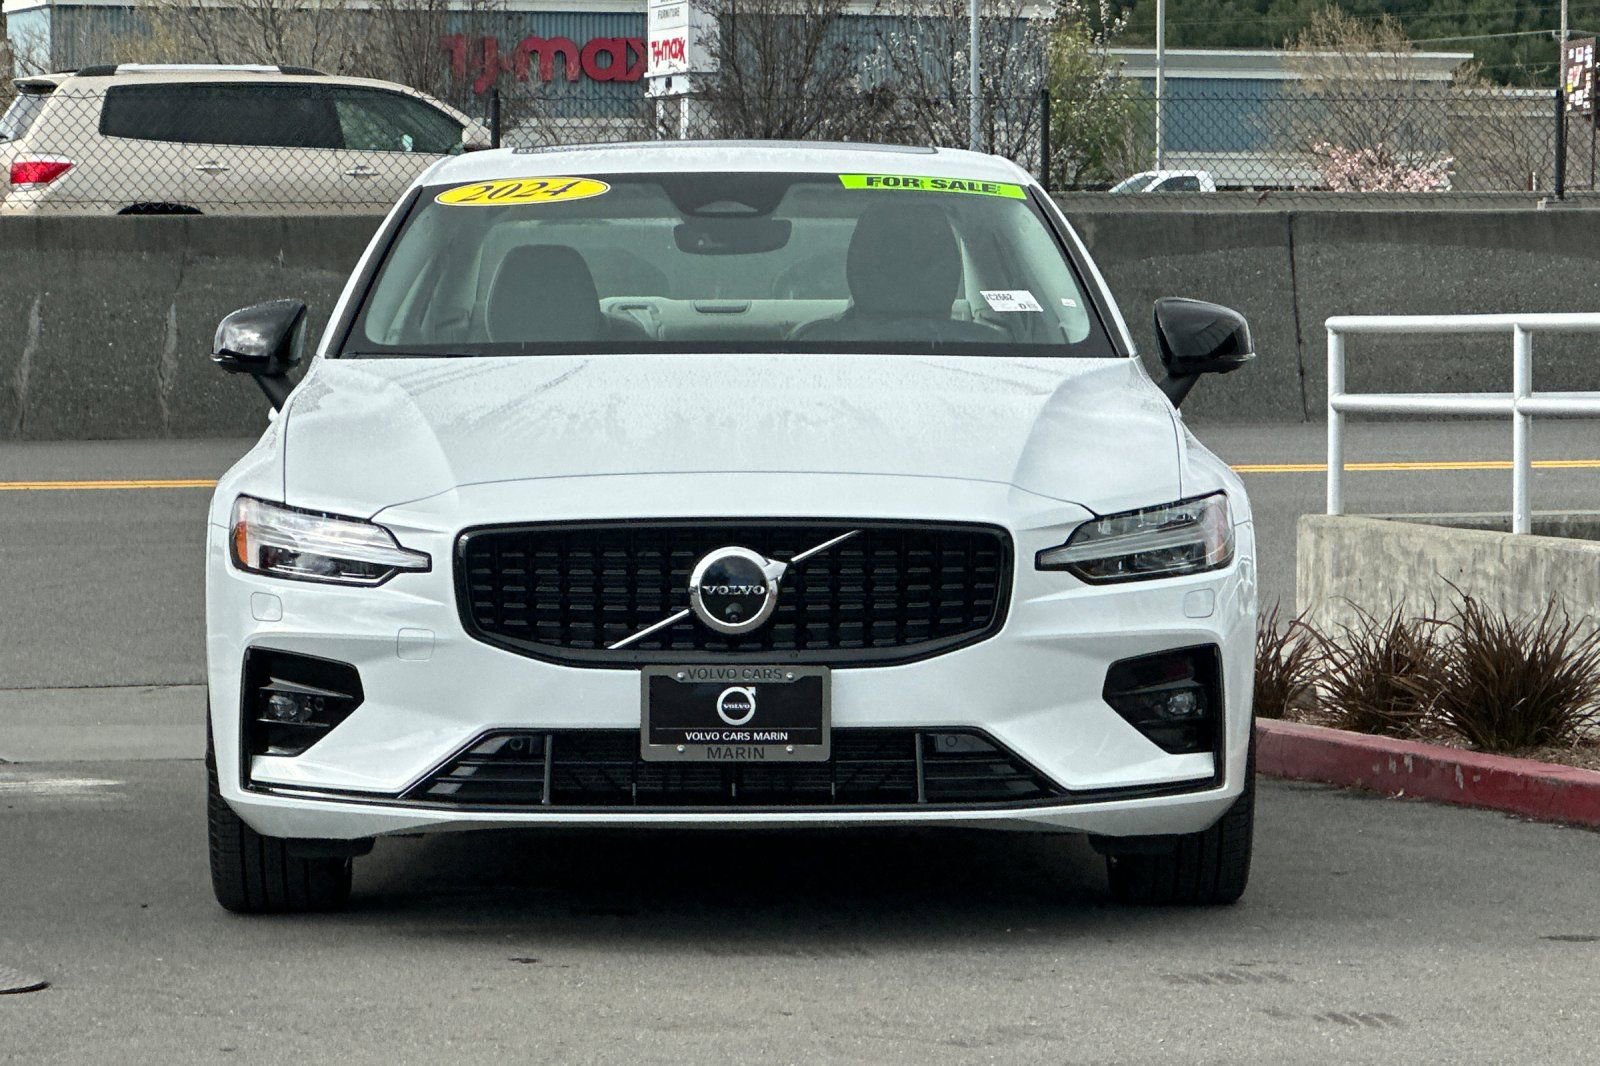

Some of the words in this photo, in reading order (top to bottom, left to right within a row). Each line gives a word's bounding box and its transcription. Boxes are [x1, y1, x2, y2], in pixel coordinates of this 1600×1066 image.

[454, 180, 582, 203] 2024
[866, 176, 924, 188] FOR
[930, 178, 999, 194] SALE
[702, 585, 766, 596] VOLVO
[687, 668, 738, 681] VOLVO
[742, 668, 783, 681] CARS
[723, 702, 751, 710] VOLVO
[685, 731, 720, 741] VOLVO
[722, 731, 751, 741] CARS
[753, 731, 788, 741] MARIN
[706, 746, 765, 760] MARIN
